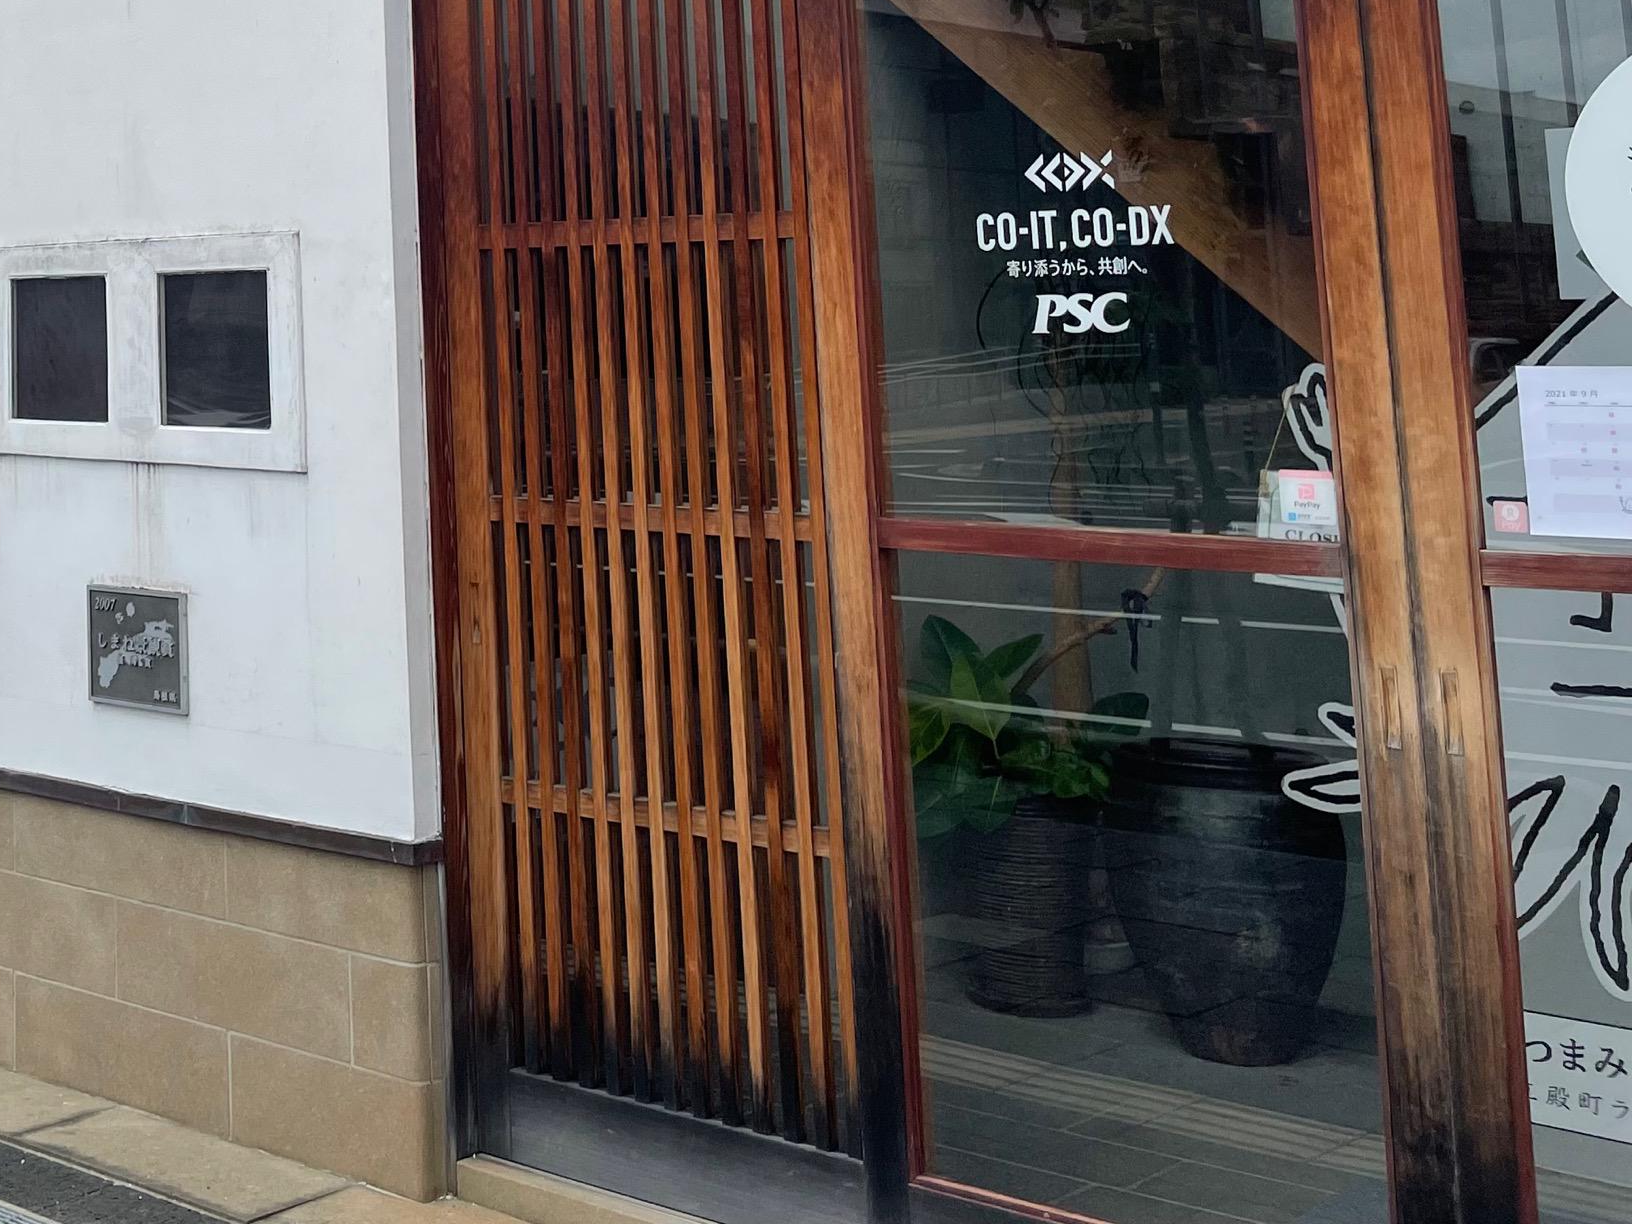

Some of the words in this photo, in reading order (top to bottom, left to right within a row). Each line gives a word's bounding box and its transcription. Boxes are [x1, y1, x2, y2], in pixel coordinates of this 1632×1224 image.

[1006, 256, 1148, 278] 寄り添うから、共創へ。
[1032, 291, 1131, 334] PSC
[95, 597, 116, 611] 2007
